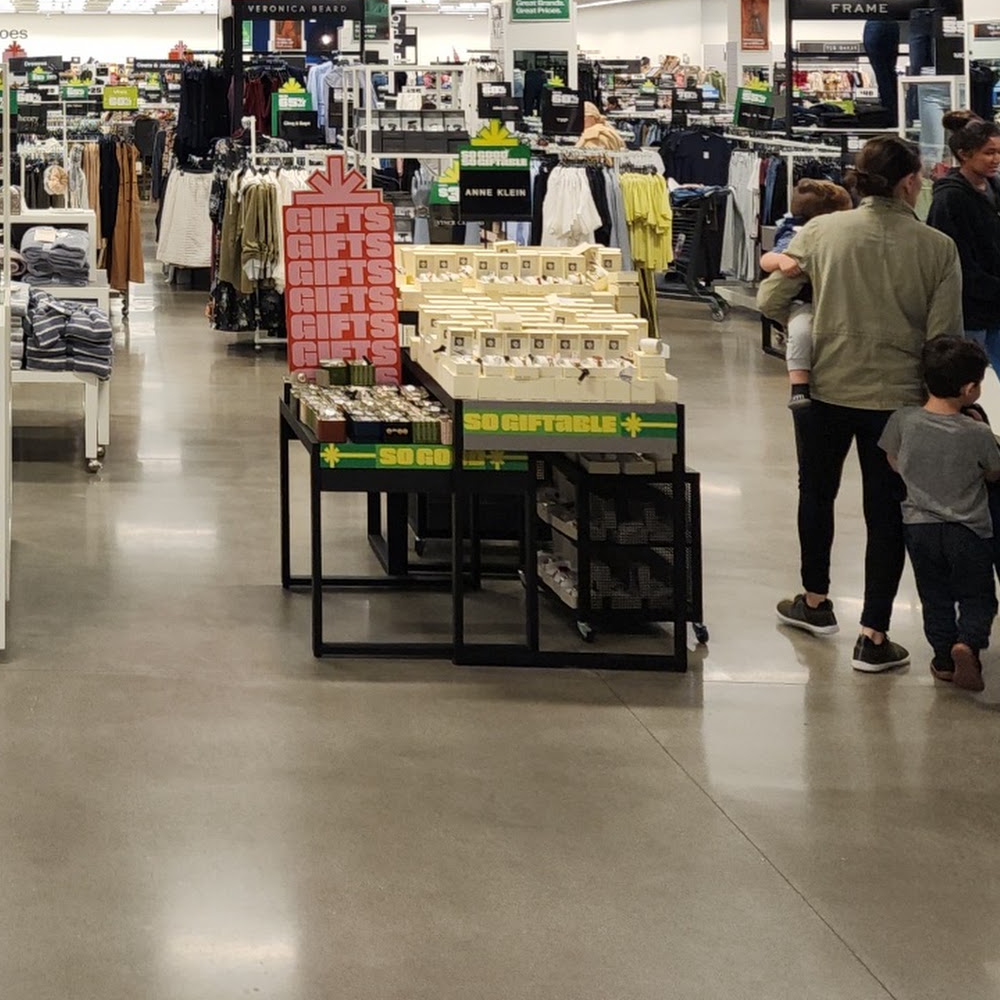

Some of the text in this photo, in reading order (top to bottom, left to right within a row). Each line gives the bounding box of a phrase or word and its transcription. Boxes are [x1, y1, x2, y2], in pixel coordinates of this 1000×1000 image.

[248, 5, 348, 13] VERONICA BEARD
[831, 3, 888, 13] FRAME
[465, 188, 526, 197] ANNE KLEIN
[285, 206, 391, 232] GIFTS
[287, 233, 392, 259] GIFTS
[288, 259, 393, 286] GIFTS
[289, 286, 395, 312] GIFTS
[291, 313, 396, 339] GIFTS
[463, 412, 499, 430] SO
[379, 447, 414, 465] SO
